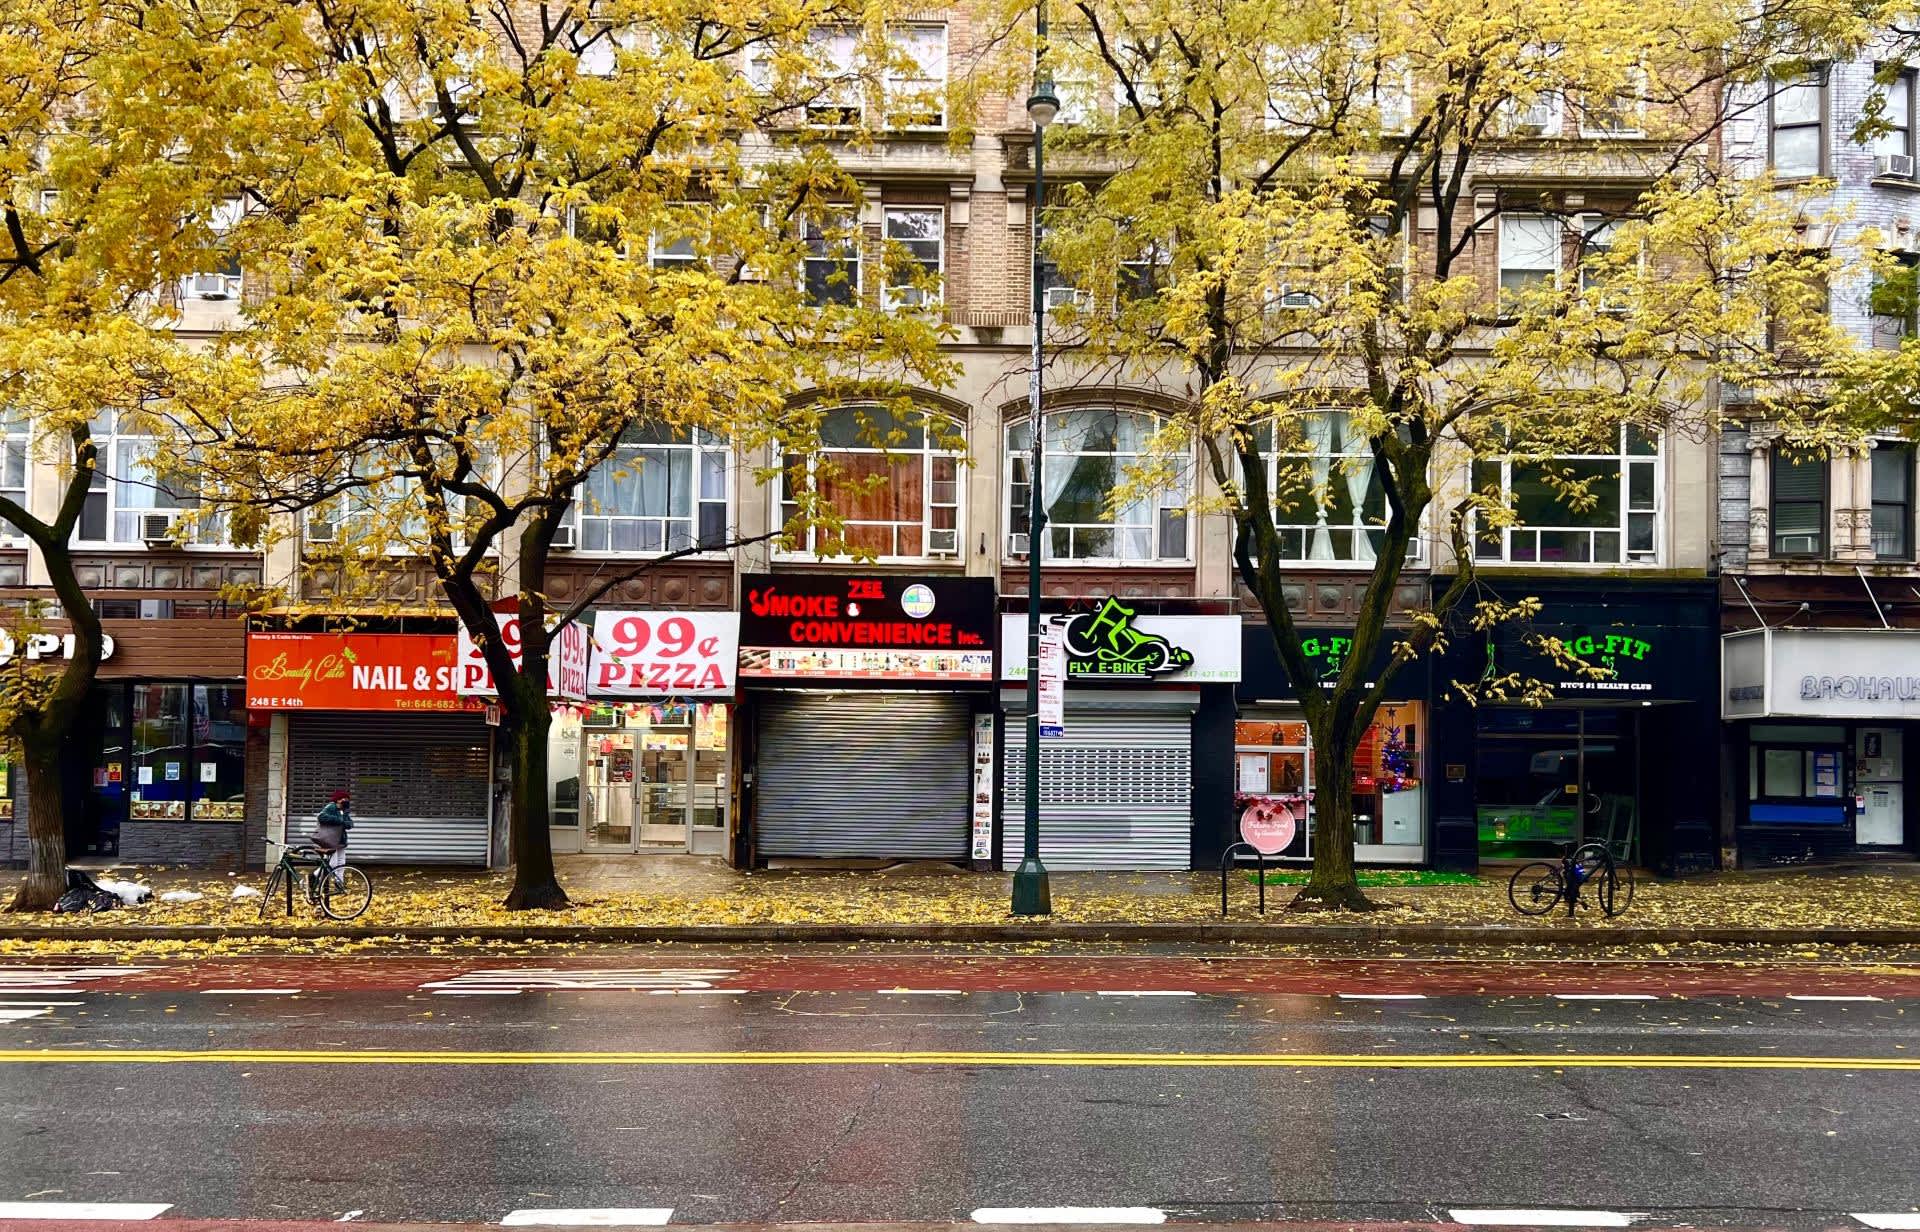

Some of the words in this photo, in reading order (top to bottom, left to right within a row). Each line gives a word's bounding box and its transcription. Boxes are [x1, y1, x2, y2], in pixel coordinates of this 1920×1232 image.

[848, 580, 885, 598] ZEE
[610, 616, 719, 658] 99¢
[790, 622, 953, 644] CONVENIENCE
[352, 666, 408, 690] NAIL
[412, 666, 431, 690] &
[598, 663, 726, 689] PIZZA
[1069, 662, 1093, 673] FLY
[1099, 662, 1146, 673] E-BIKE
[562, 667, 584, 695] PIZZA
[250, 697, 269, 706] 248
[271, 698, 279, 706] E
[281, 697, 303, 706] 14th
